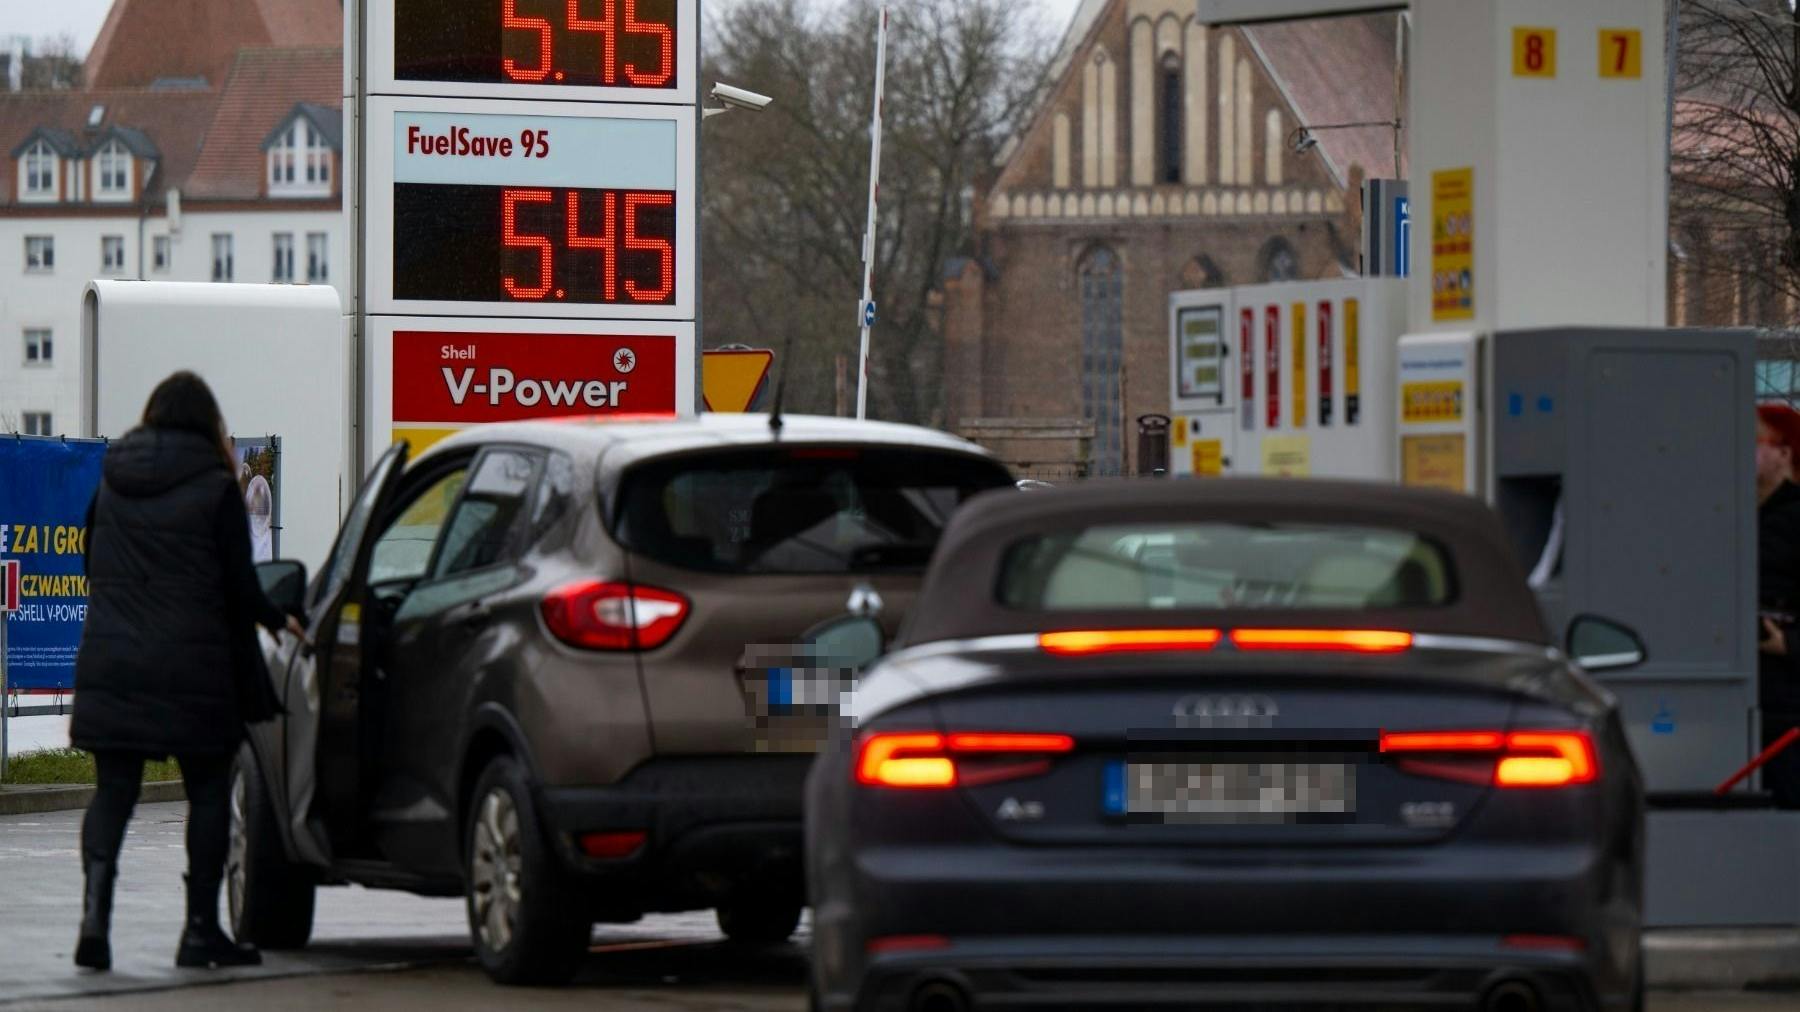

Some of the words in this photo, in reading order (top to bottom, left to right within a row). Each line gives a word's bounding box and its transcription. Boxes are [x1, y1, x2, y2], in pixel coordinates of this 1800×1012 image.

[503, 0, 672, 85] 5.45
[1525, 34, 1543, 72] 8
[1612, 35, 1628, 73] 7
[408, 127, 513, 156] FuelSave
[520, 130, 549, 158] 95
[504, 190, 672, 301] 5.45
[441, 345, 476, 360] Shell
[441, 367, 627, 407] V-Power
[12, 524, 38, 553] ZA
[19, 604, 45, 621] SHELL
